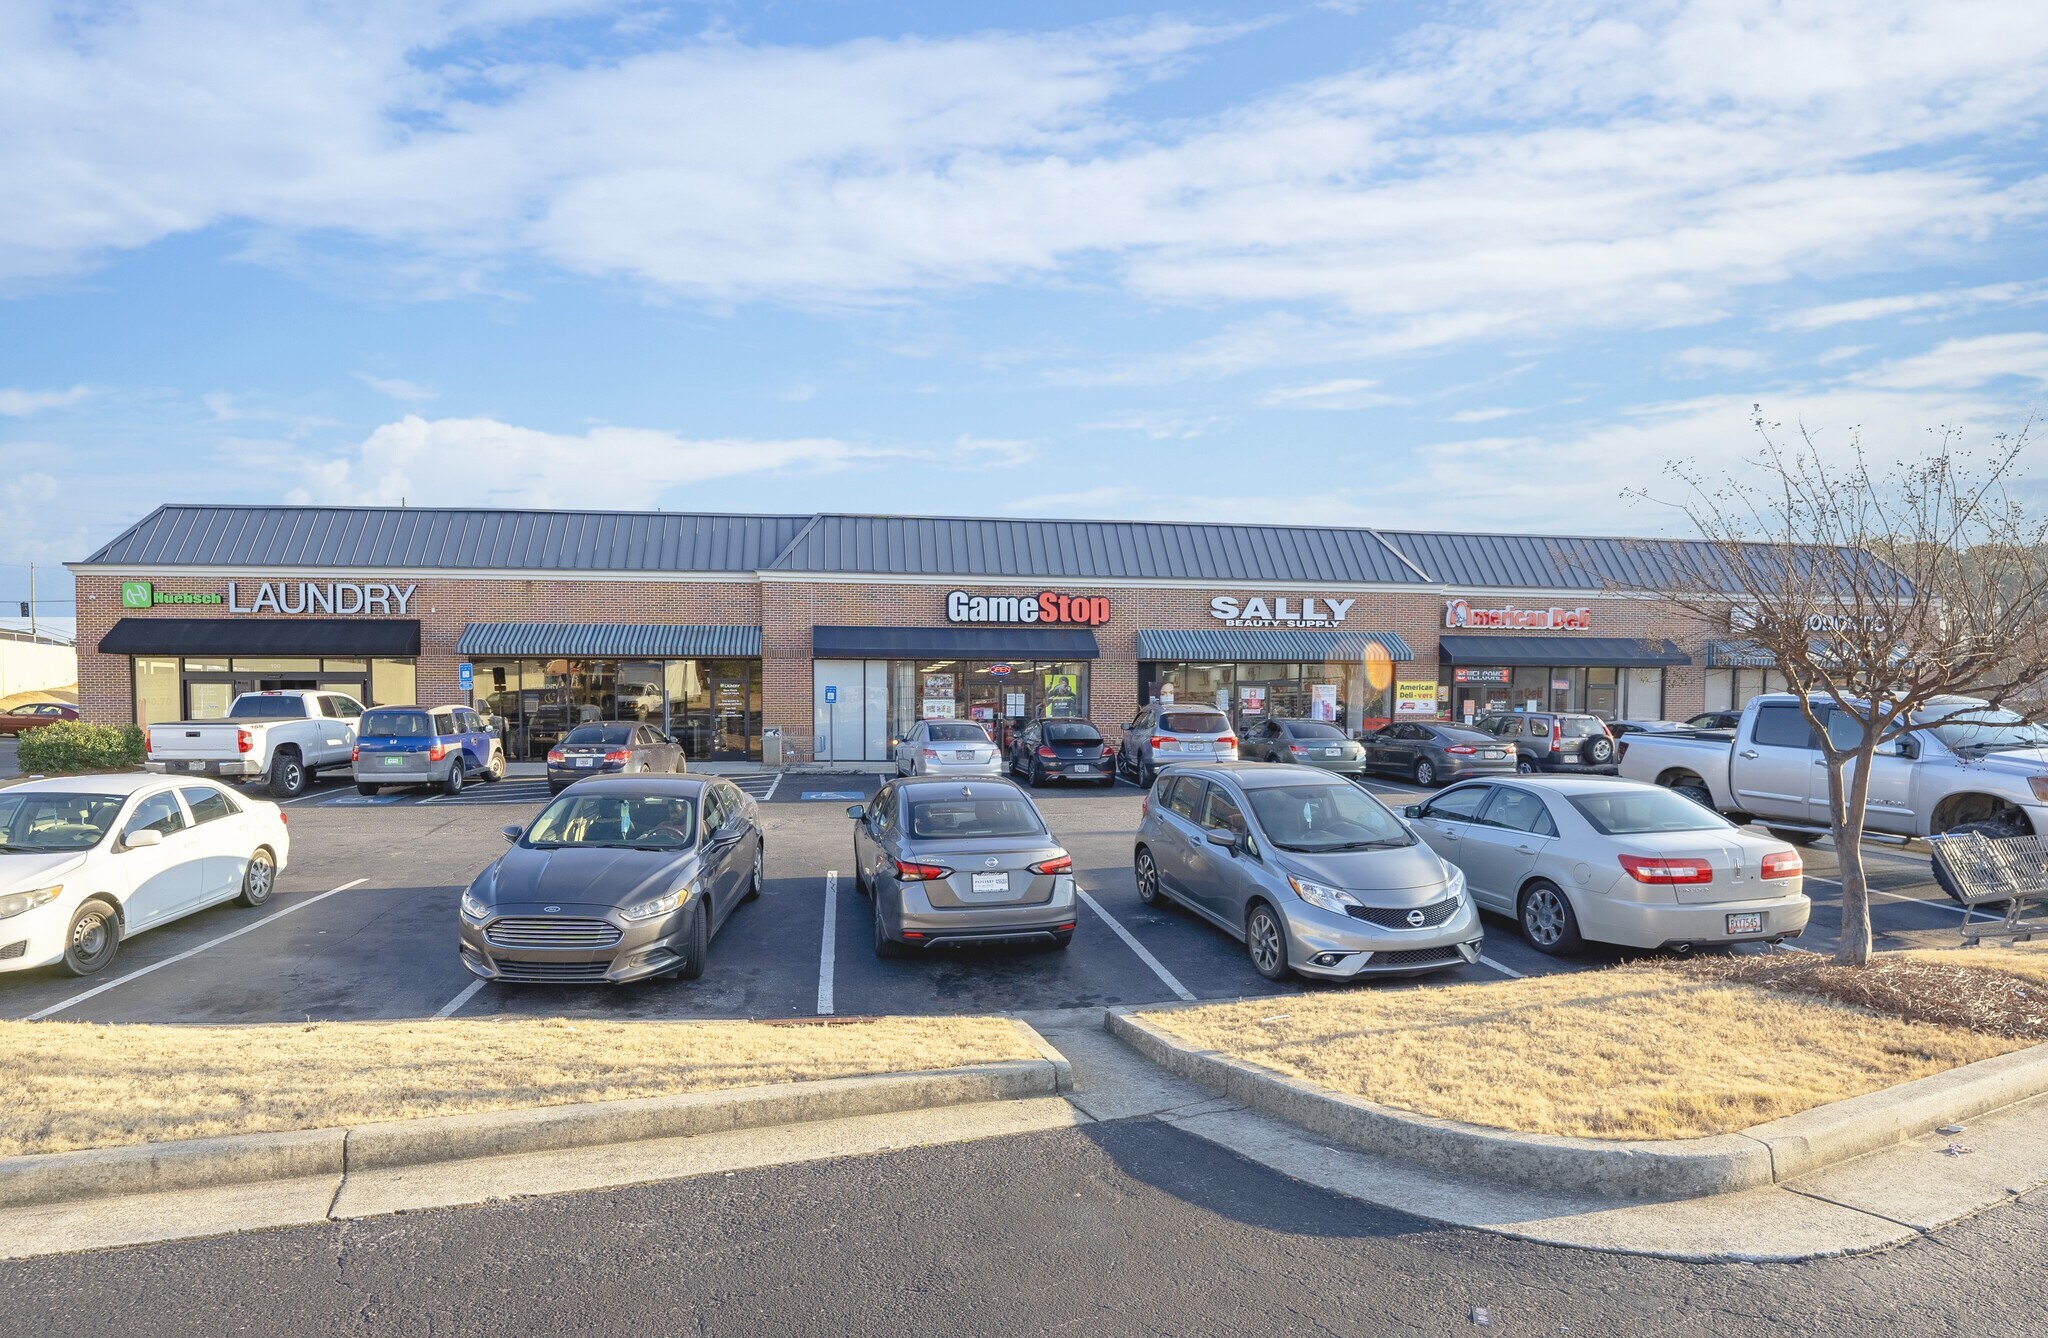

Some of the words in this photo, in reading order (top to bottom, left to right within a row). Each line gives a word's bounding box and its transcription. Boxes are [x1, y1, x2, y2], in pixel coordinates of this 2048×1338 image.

[153, 592, 222, 604] Huebsch
[228, 582, 417, 615] LAUNDRY
[947, 590, 1111, 626] GameStop
[1210, 596, 1356, 620] SALLY
[1225, 619, 1281, 627] BEAUTY
[1286, 620, 1340, 628] SUPPLY
[1447, 600, 1549, 628] American
[1552, 608, 1591, 629] Deli
[1467, 670, 1503, 681] WELCOME
